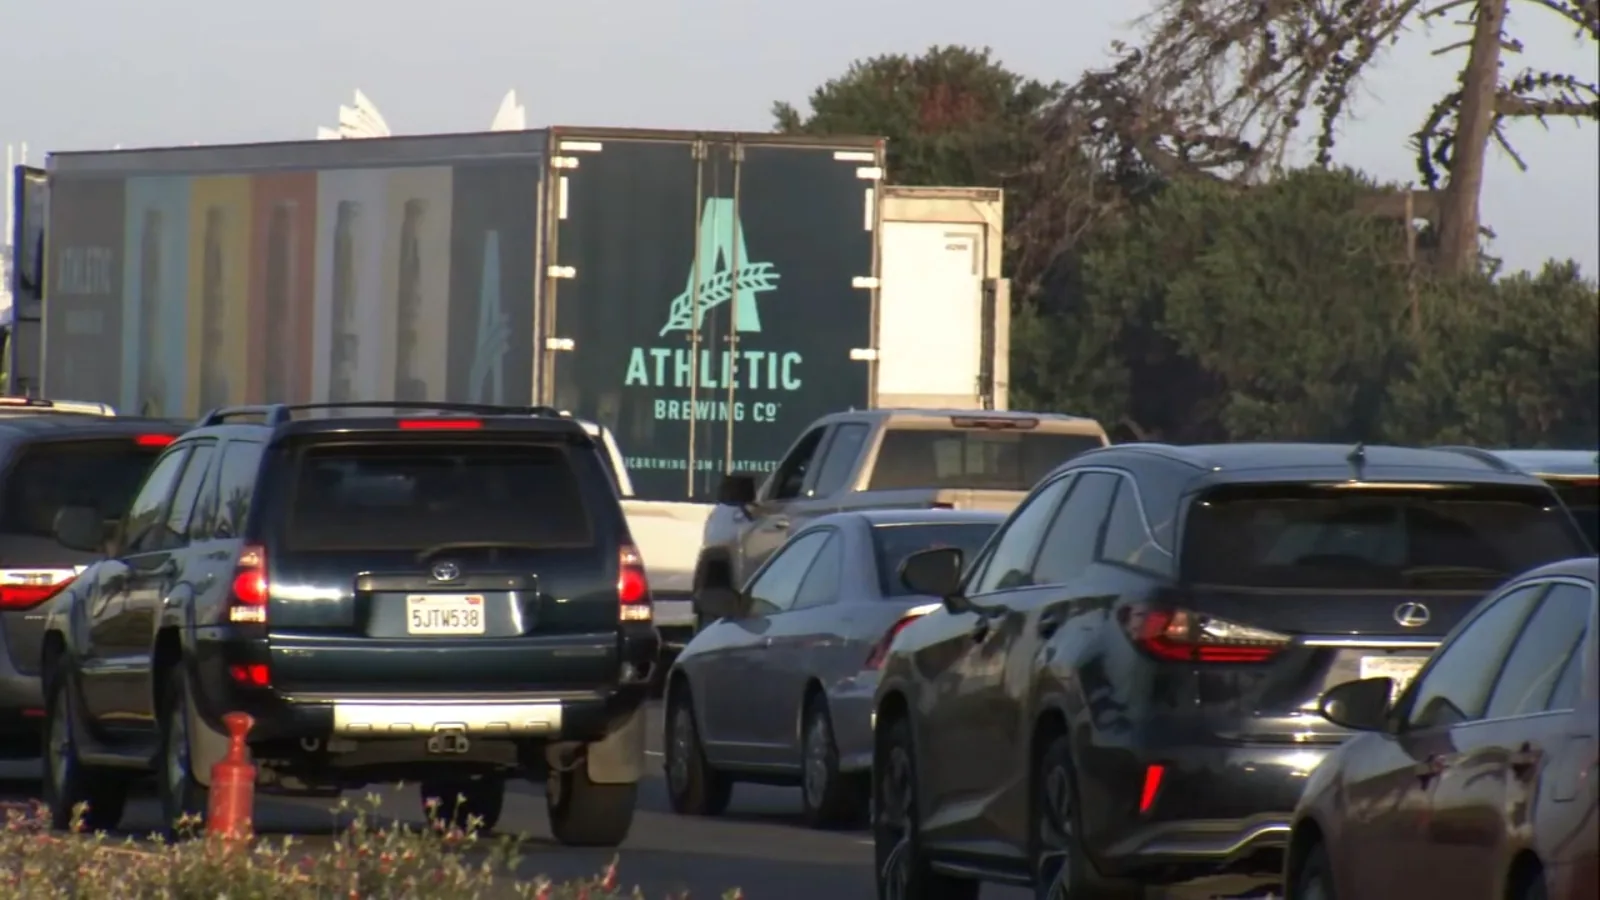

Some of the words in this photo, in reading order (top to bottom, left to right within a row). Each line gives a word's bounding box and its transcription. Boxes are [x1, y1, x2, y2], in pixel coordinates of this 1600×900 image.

[624, 347, 803, 391] ATHLETIC
[654, 400, 744, 421] BREWING
[412, 608, 480, 628] 5JTW538
